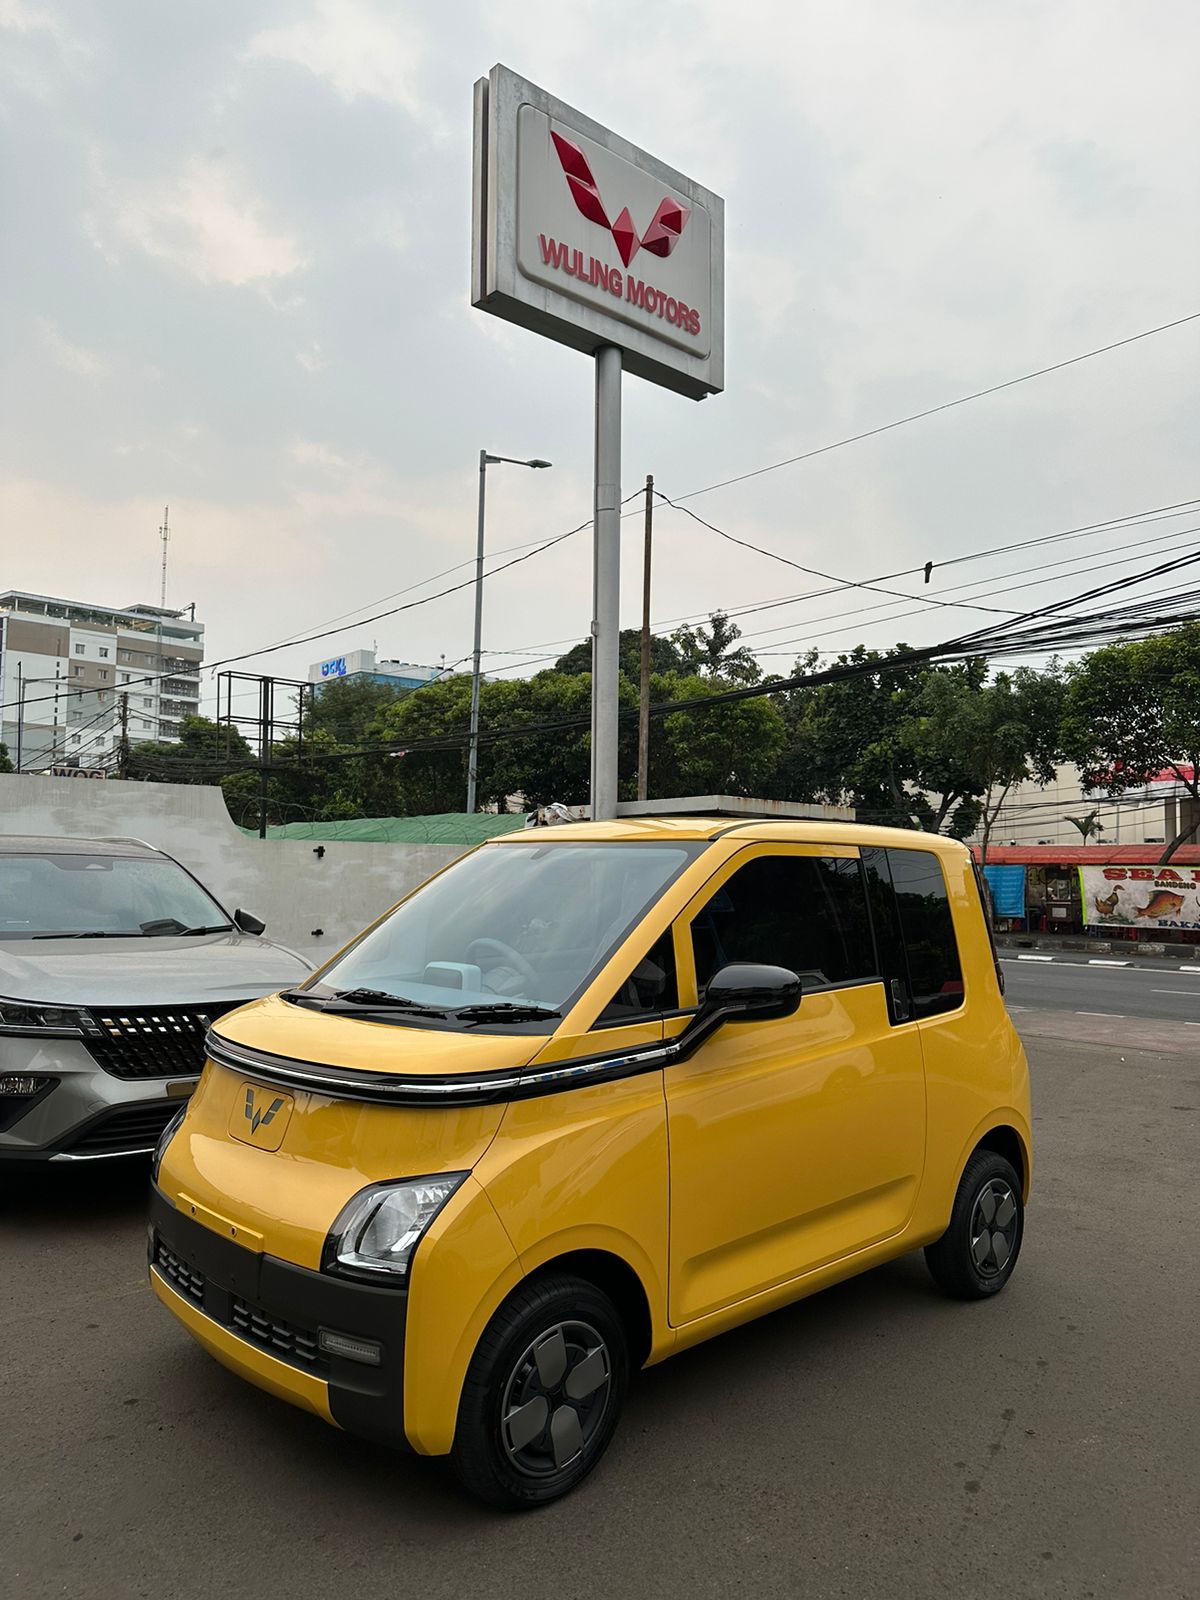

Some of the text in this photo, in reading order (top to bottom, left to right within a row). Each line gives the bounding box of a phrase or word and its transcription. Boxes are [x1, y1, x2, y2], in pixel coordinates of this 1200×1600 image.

[540, 233, 701, 336] WULING MOTORS
[1102, 868, 1183, 881] SEA
[1154, 881, 1196, 890] BANDENG
